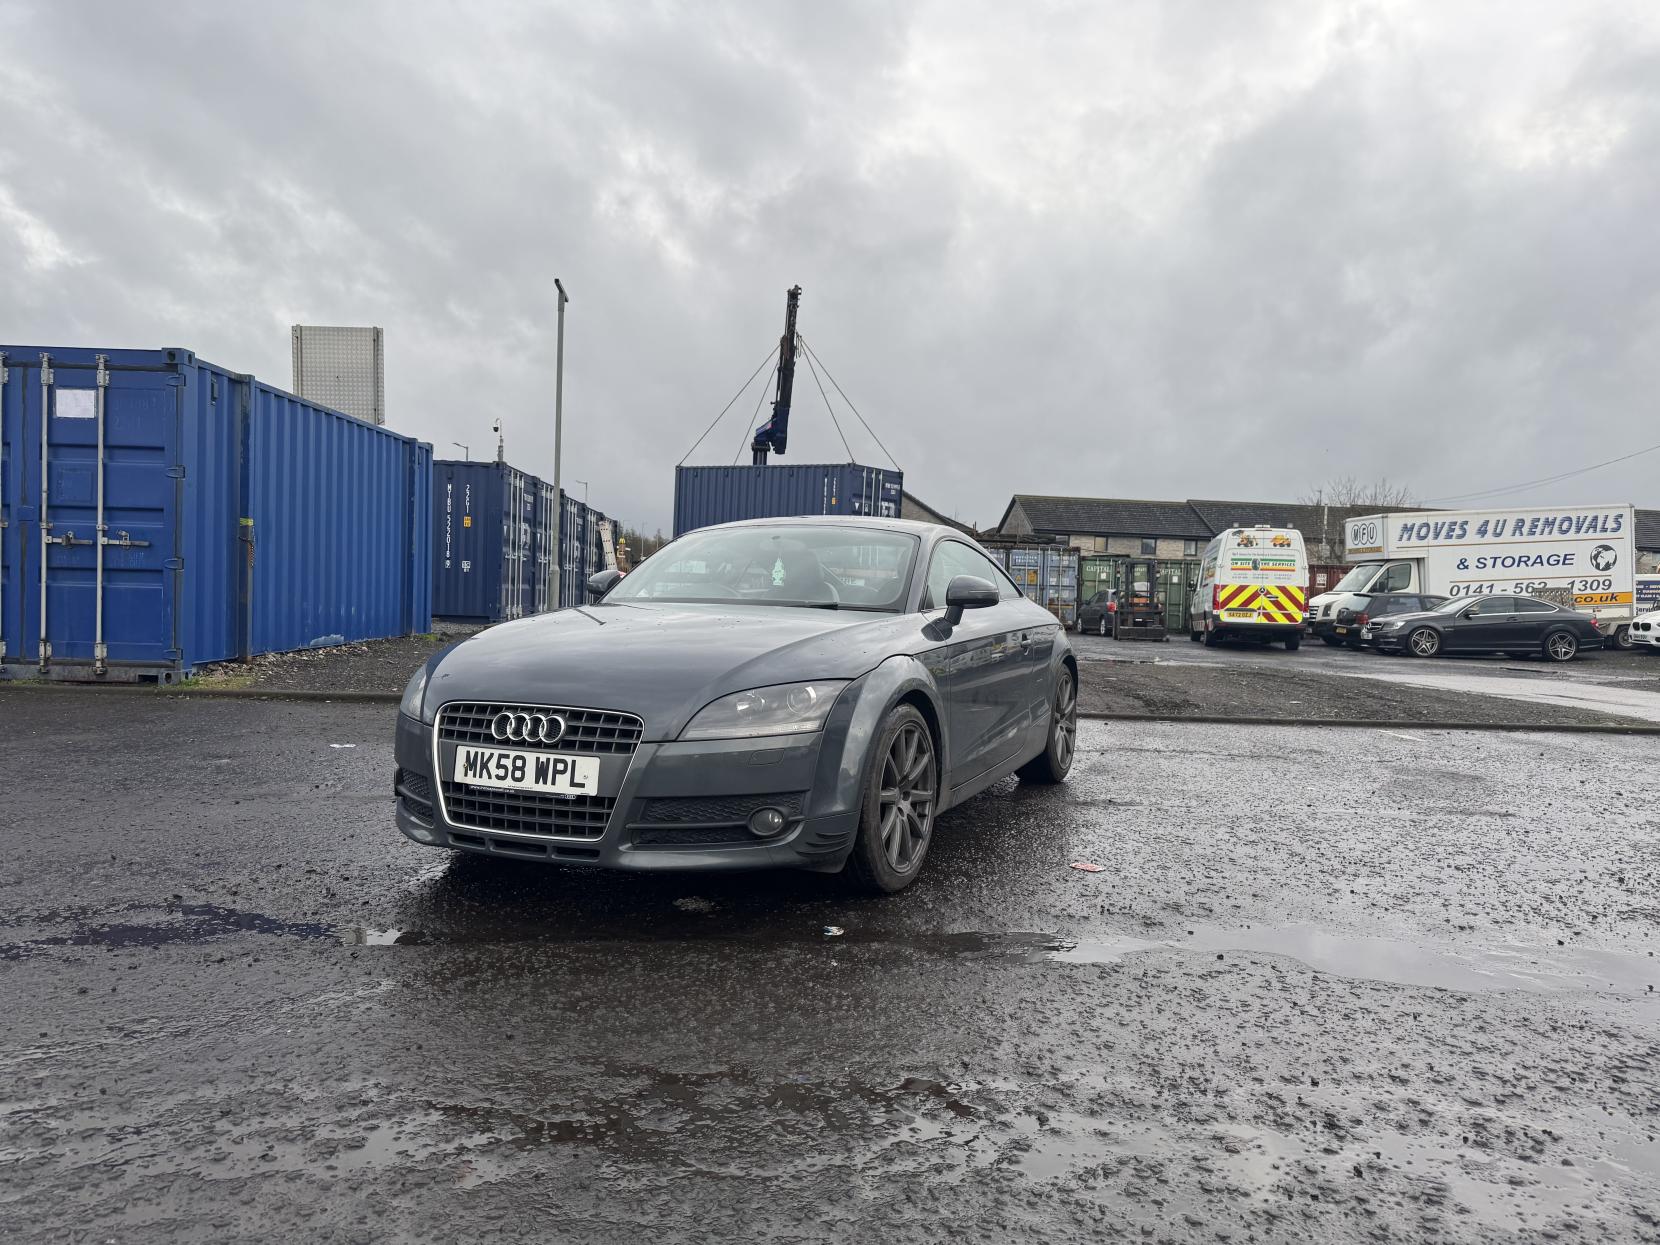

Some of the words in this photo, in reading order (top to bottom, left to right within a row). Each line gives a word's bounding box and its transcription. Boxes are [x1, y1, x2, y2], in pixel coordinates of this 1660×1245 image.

[1352, 524, 1376, 544] MFU
[1398, 520, 1469, 542] MOVES
[1510, 514, 1623, 536] REMOVALS
[1456, 557, 1470, 570] &
[1475, 553, 1576, 569] STORAGE
[1449, 583, 1495, 596] 0141
[1566, 578, 1612, 593] 1309
[464, 750, 526, 782] MK58
[534, 756, 586, 788] WPL
